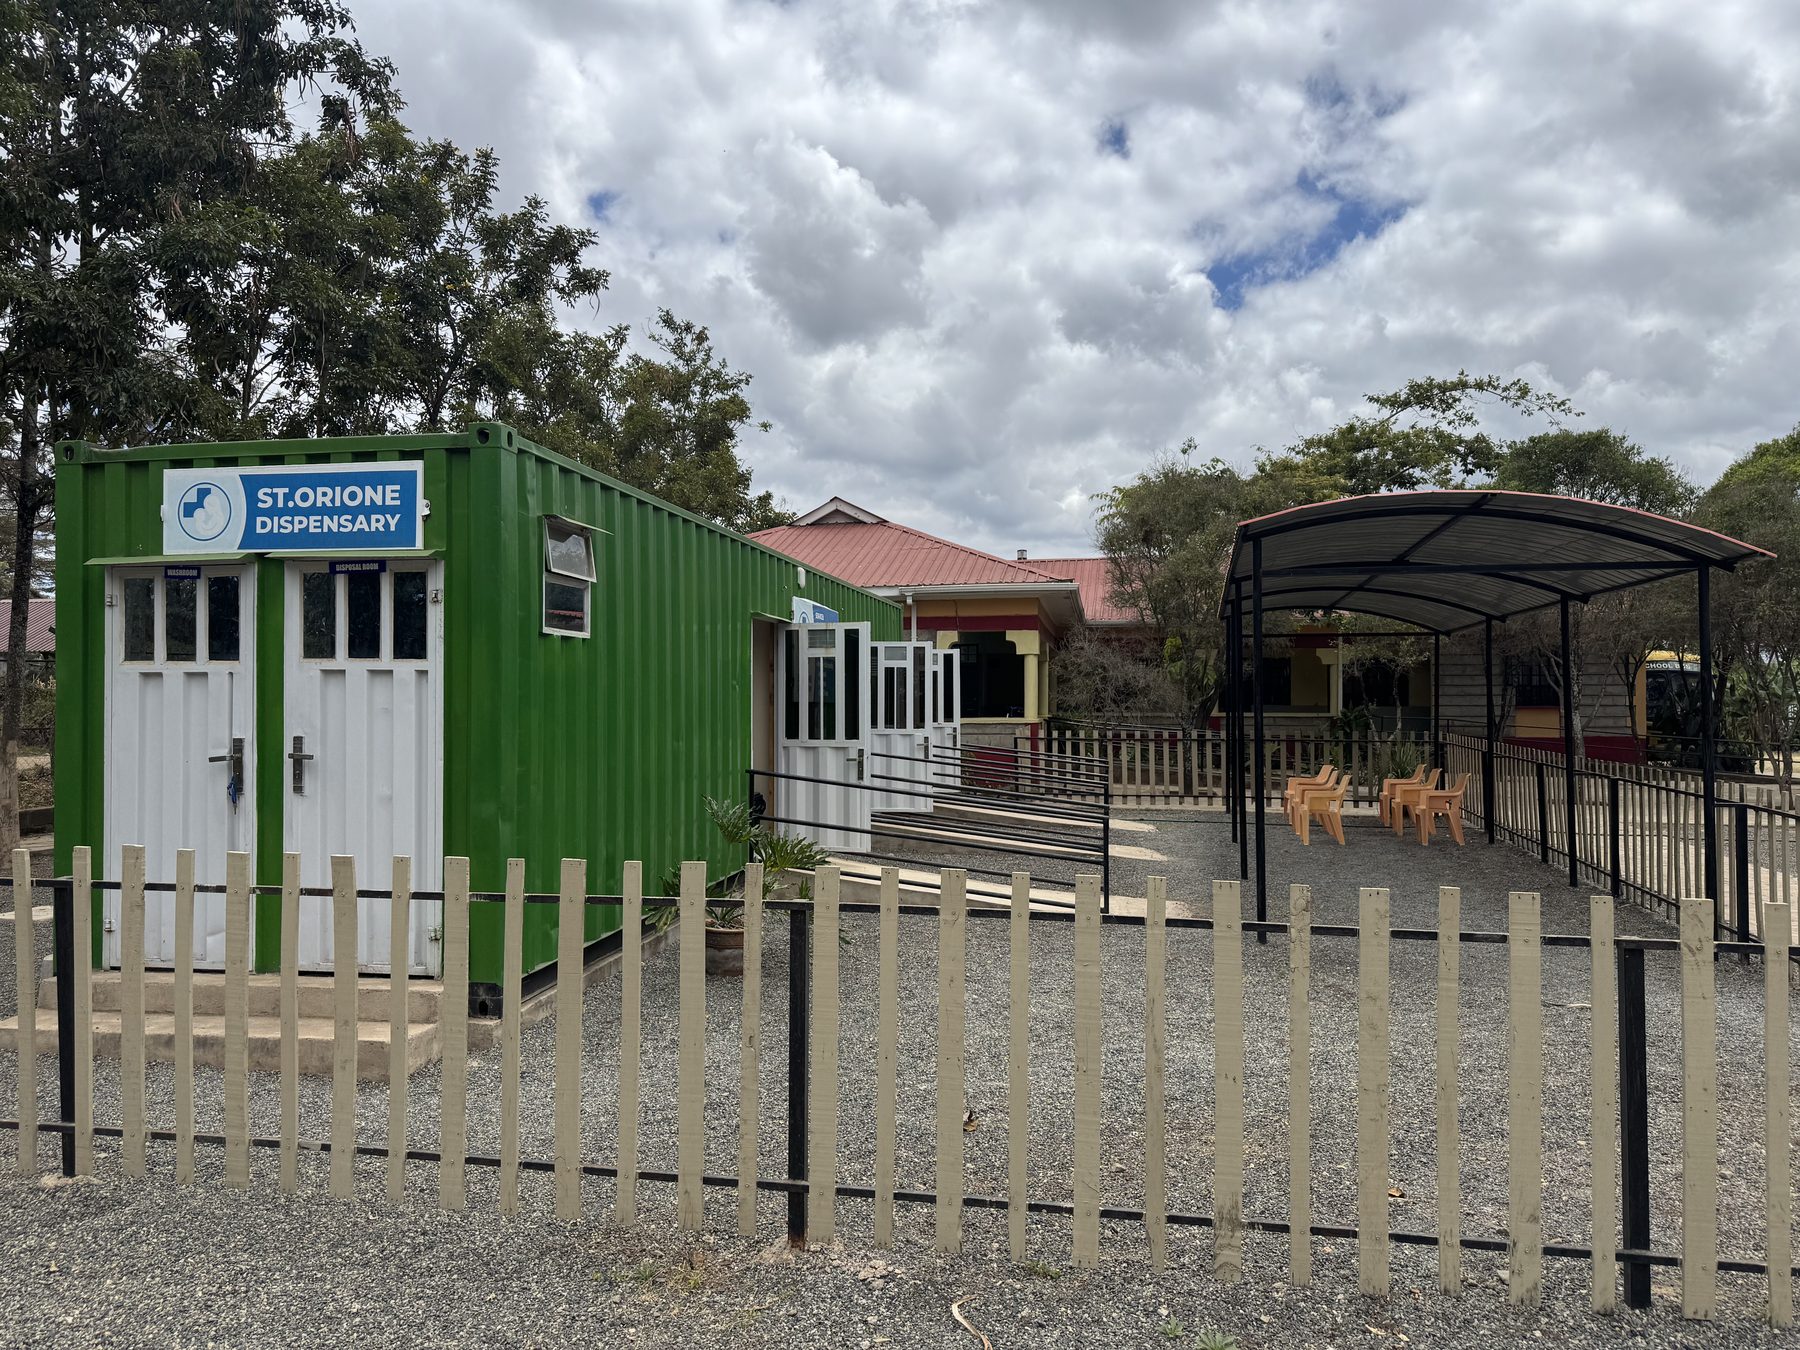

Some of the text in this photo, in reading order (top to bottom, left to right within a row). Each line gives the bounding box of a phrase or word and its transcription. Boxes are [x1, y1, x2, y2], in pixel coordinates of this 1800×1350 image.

[257, 485, 401, 508] ST.ORIONE
[255, 515, 401, 534] DISPENSARY
[167, 569, 198, 577] WASHROOM
[335, 562, 379, 571] DISPOSAL ROOM
